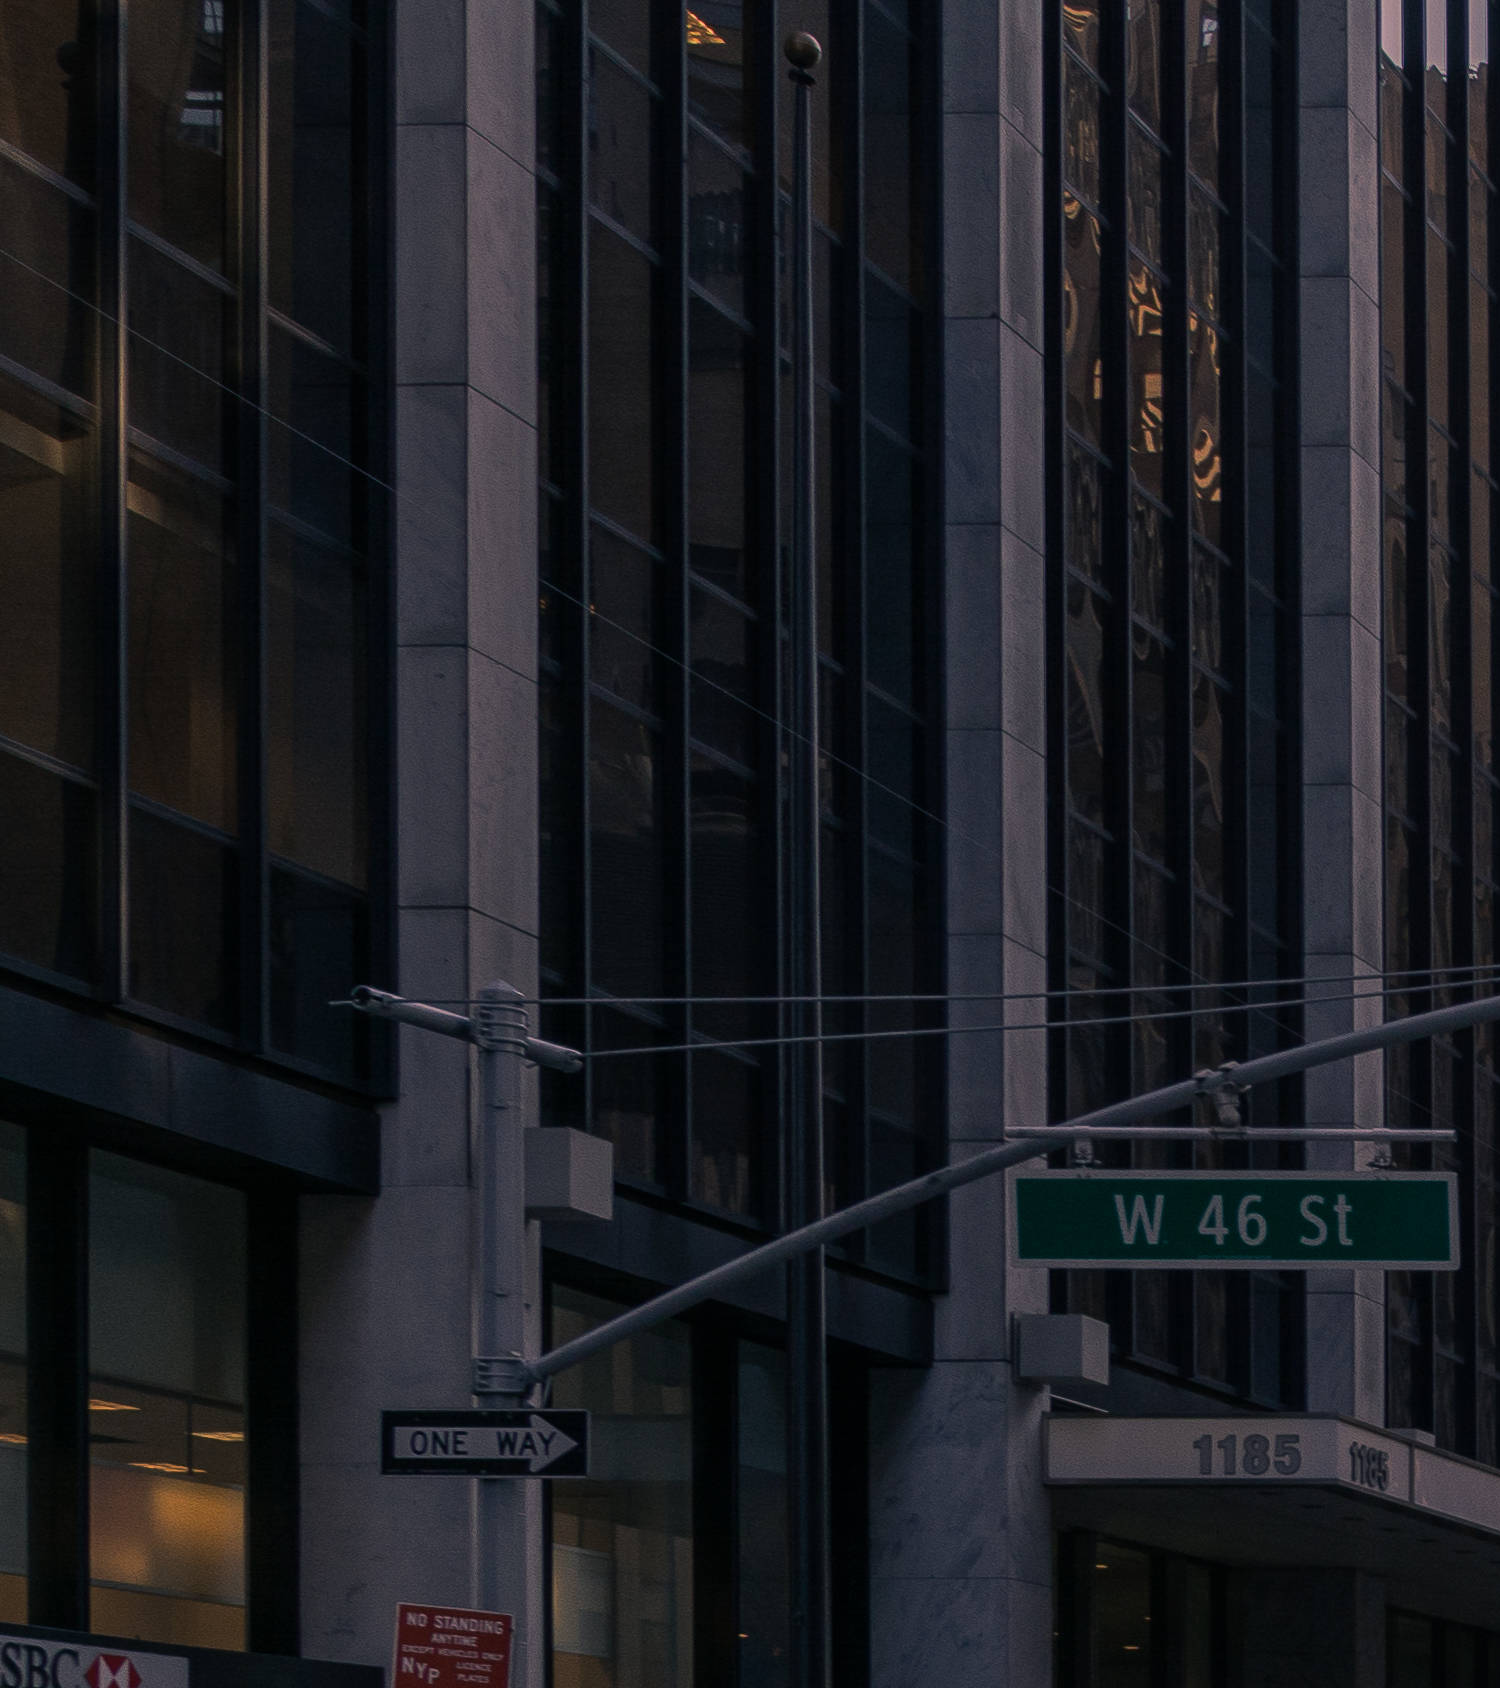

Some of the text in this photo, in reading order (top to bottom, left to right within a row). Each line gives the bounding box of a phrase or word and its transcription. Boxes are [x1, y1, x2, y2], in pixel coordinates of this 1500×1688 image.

[1113, 1193, 1354, 1246] W 46 St
[410, 1431, 555, 1455] ONE WAY
[1193, 1434, 1301, 1476] 1185
[406, 1611, 503, 1635] NO STANDING
[431, 1632, 478, 1647] ANYTIME
[401, 1655, 440, 1685] NYP
